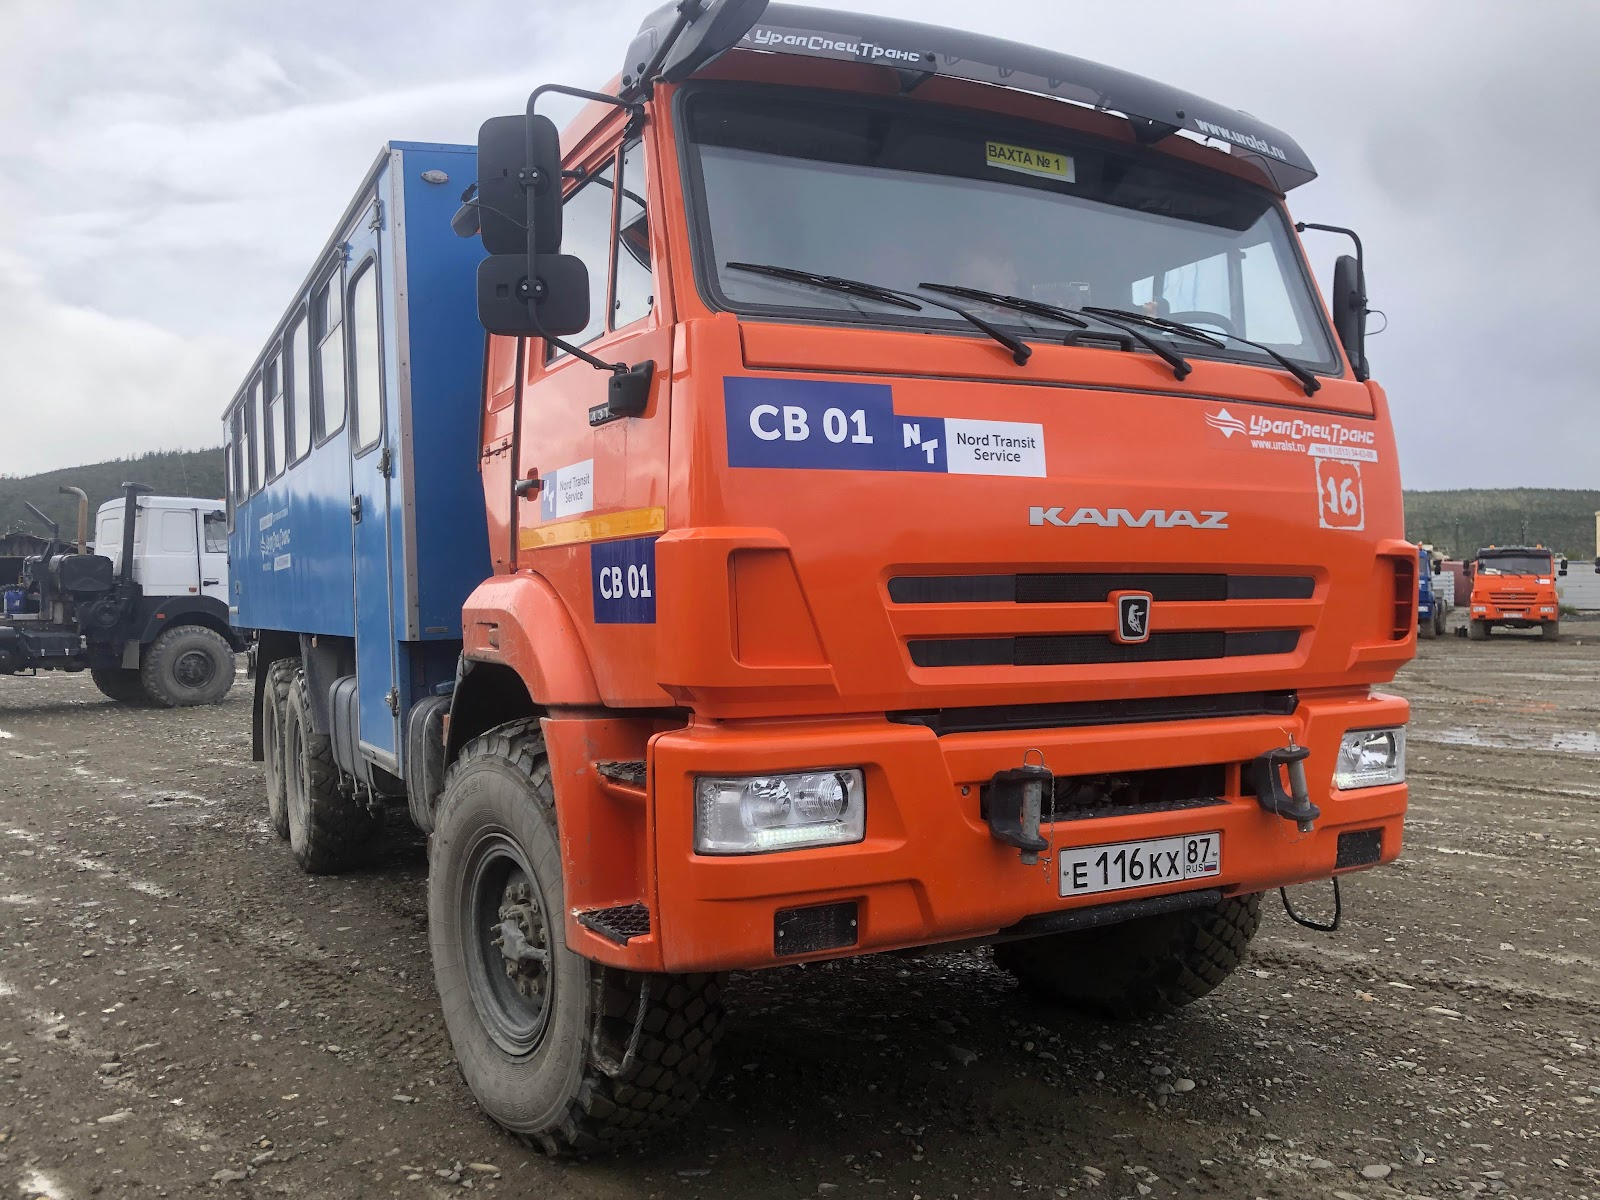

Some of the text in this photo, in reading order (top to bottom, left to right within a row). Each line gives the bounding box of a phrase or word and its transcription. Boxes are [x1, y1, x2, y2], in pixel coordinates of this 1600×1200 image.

[754, 29, 920, 62] УралСпецТранс
[1194, 118, 1286, 160] www.uralst.ru
[988, 144, 1032, 165] ВАХТА
[1055, 158, 1060, 171] 1
[822, 407, 874, 444] 01
[1248, 415, 1375, 444] УралСпецТранс
[957, 432, 1036, 449] Nord Transit
[1250, 440, 1306, 453] www.uralst.ru
[974, 448, 1021, 462] Service
[560, 473, 590, 491] Nord Transit
[565, 490, 583, 503] Service
[1325, 476, 1358, 516] 16
[1029, 506, 1229, 530] KAMAZ
[627, 563, 652, 598] 01
[1187, 838, 1211, 864] 87
[1186, 862, 1204, 874] RUS
